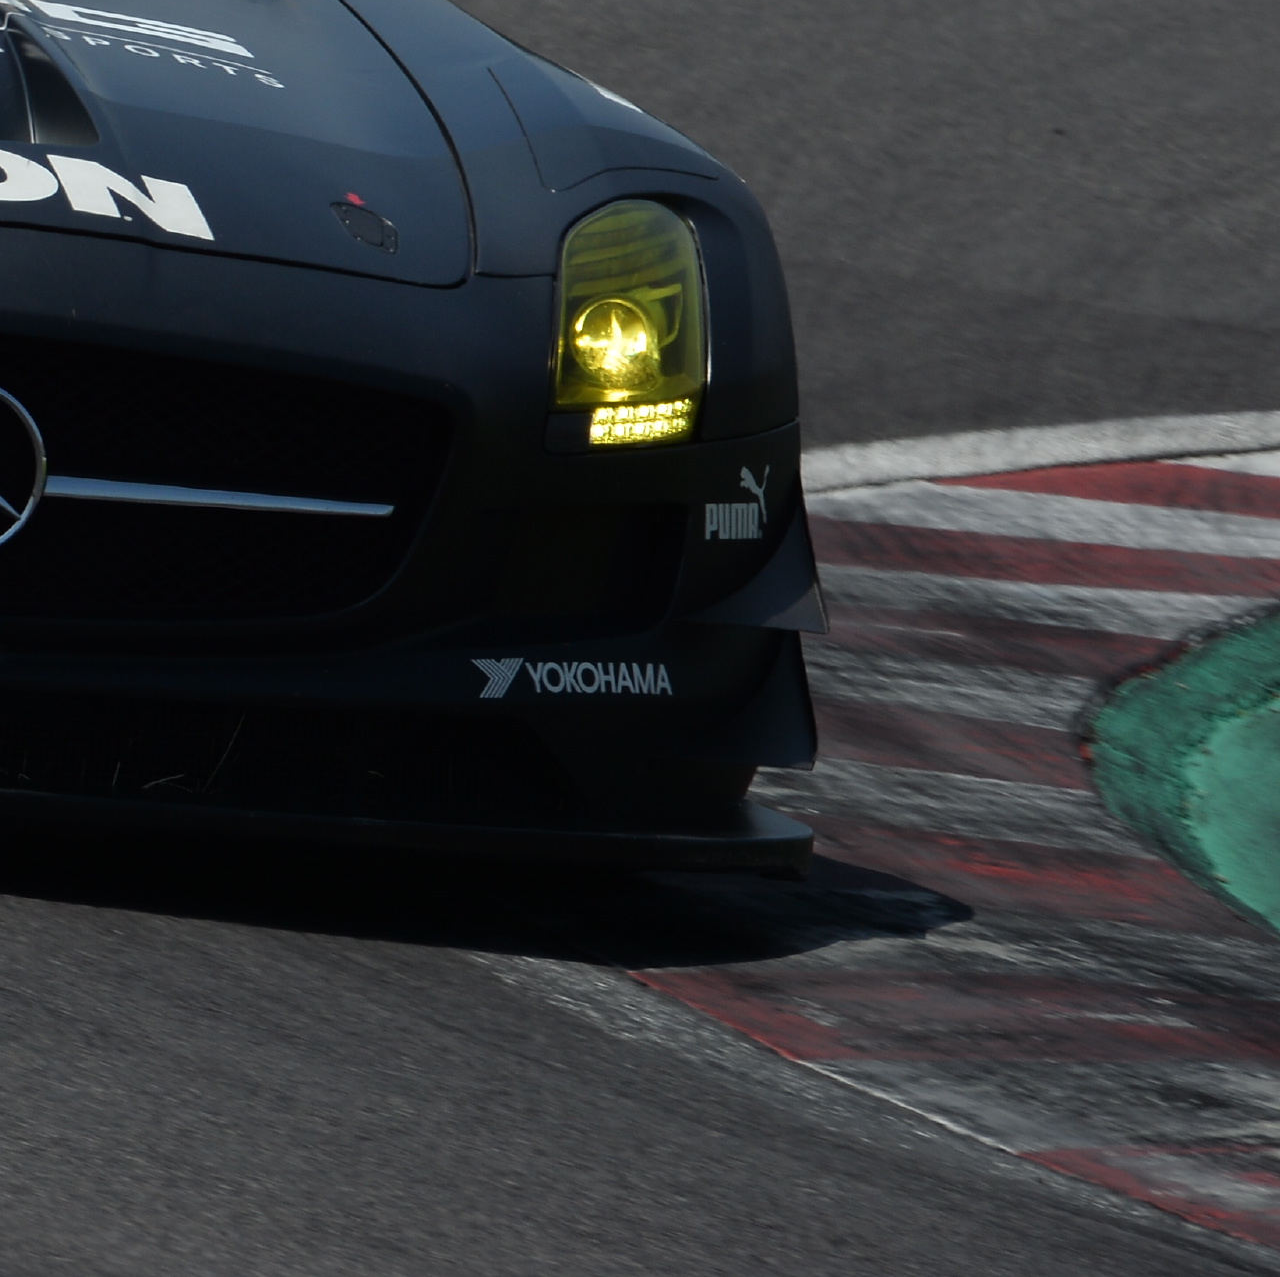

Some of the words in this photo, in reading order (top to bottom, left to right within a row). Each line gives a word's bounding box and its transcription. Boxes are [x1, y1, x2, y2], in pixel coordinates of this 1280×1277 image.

[42, 25, 285, 88] SPORTS
[705, 502, 760, 540] PUMA
[525, 662, 673, 696] YOKOHAMA
